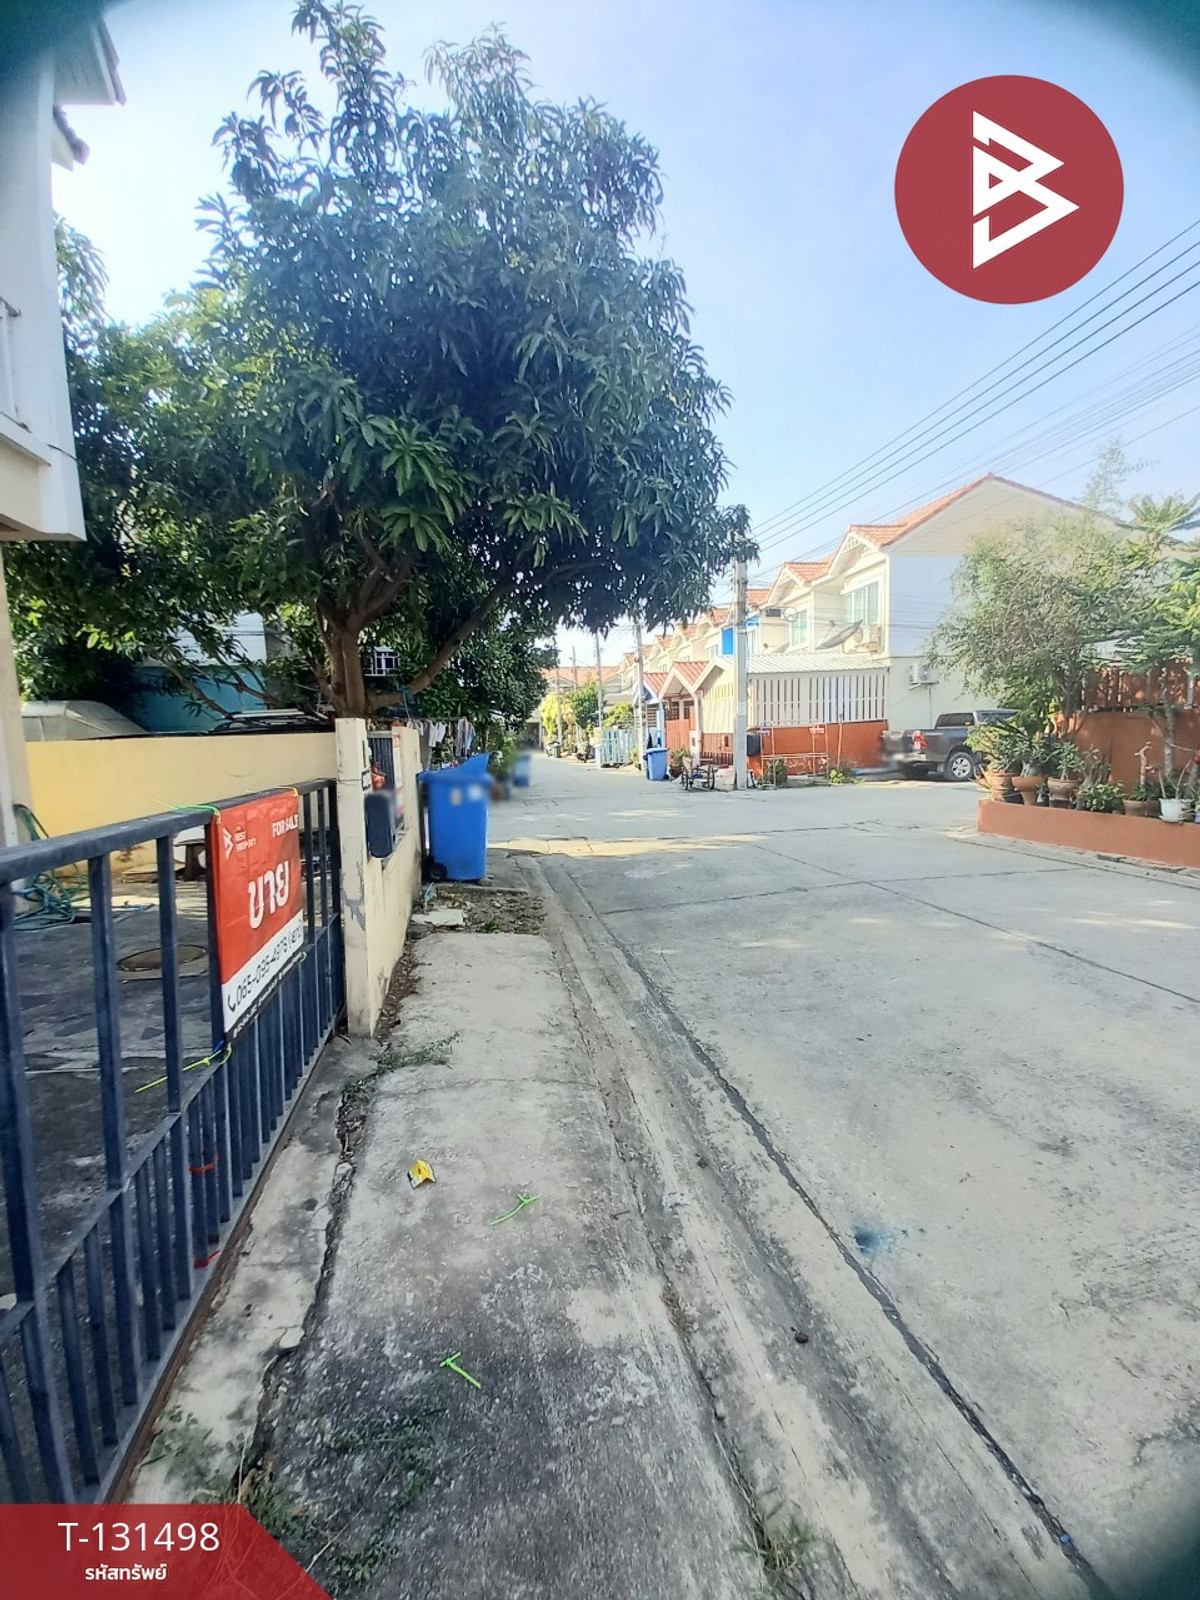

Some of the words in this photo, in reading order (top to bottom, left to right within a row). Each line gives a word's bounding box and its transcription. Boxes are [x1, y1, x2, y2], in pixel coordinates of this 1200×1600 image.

[272, 820, 285, 838] FOR
[285, 813, 299, 831] SALE
[248, 860, 289, 929] ขาย
